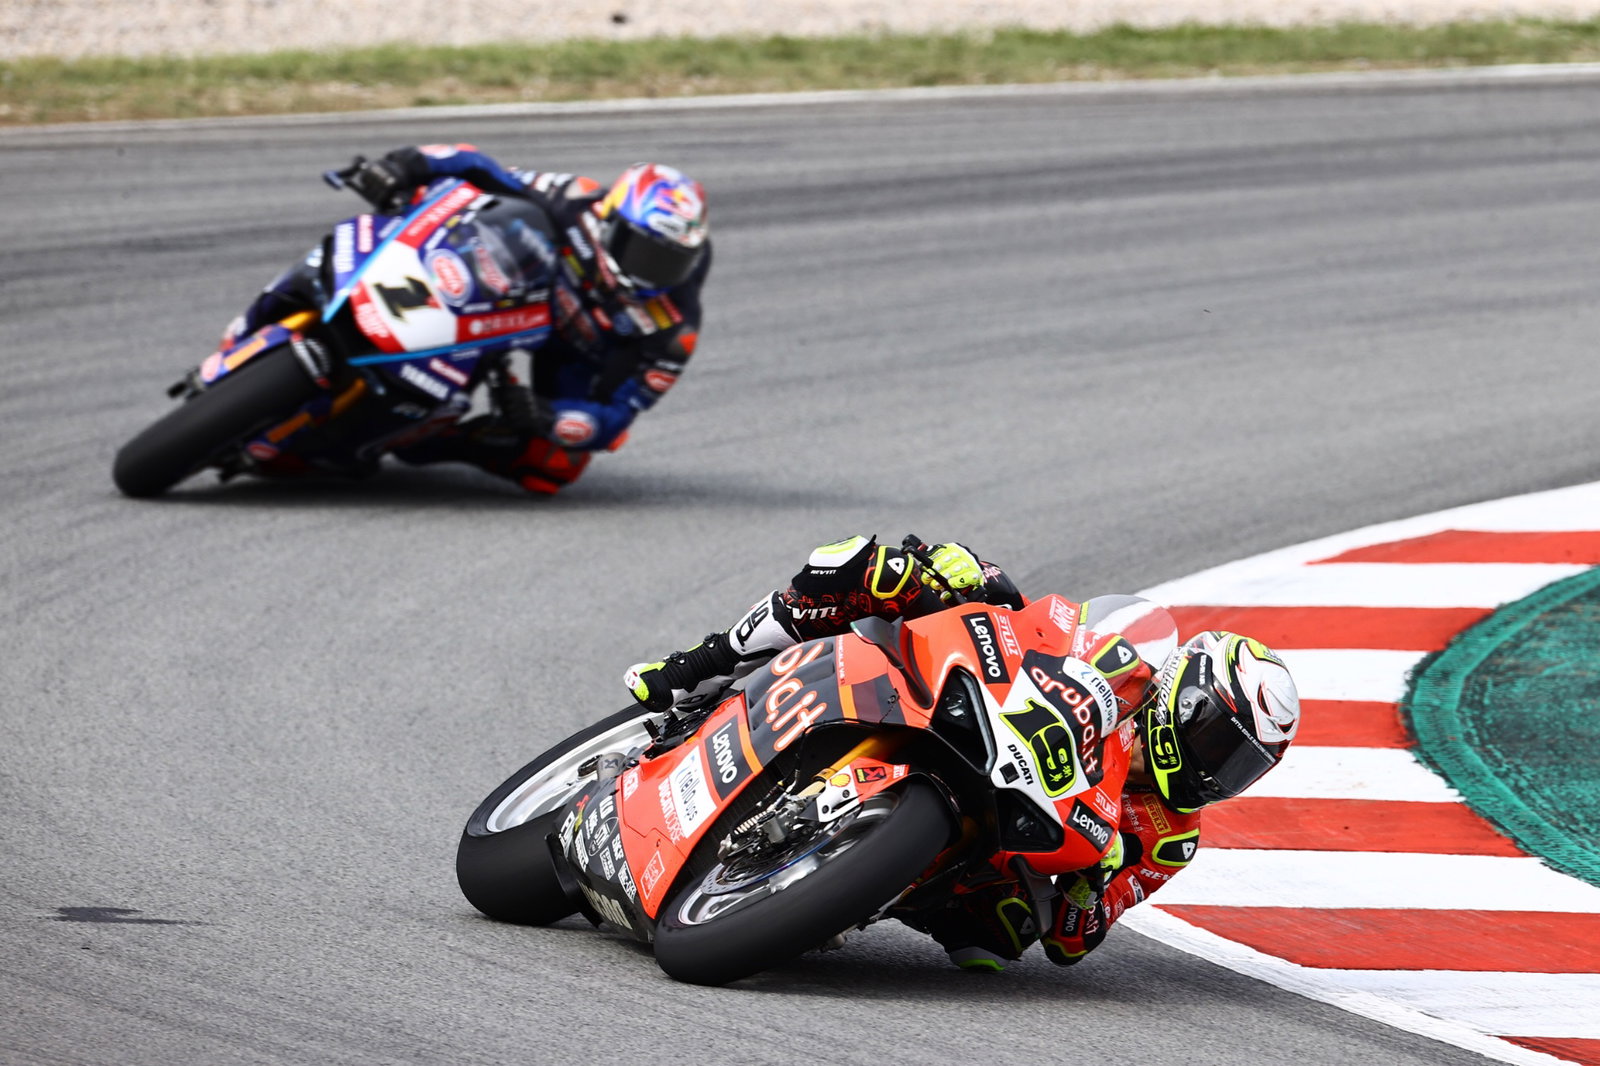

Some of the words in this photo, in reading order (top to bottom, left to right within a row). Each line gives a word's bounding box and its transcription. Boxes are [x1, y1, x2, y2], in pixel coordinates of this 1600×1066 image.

[373, 277, 434, 320] 1
[969, 616, 1001, 678] Lenovo
[1091, 676, 1113, 708] riello
[1029, 665, 1099, 775] aruba.it
[713, 723, 738, 784] Lenovo
[999, 697, 1077, 797] 19
[1007, 744, 1034, 785] DUCATI
[677, 768, 700, 805] riello
[1072, 805, 1109, 845] Lenovo
